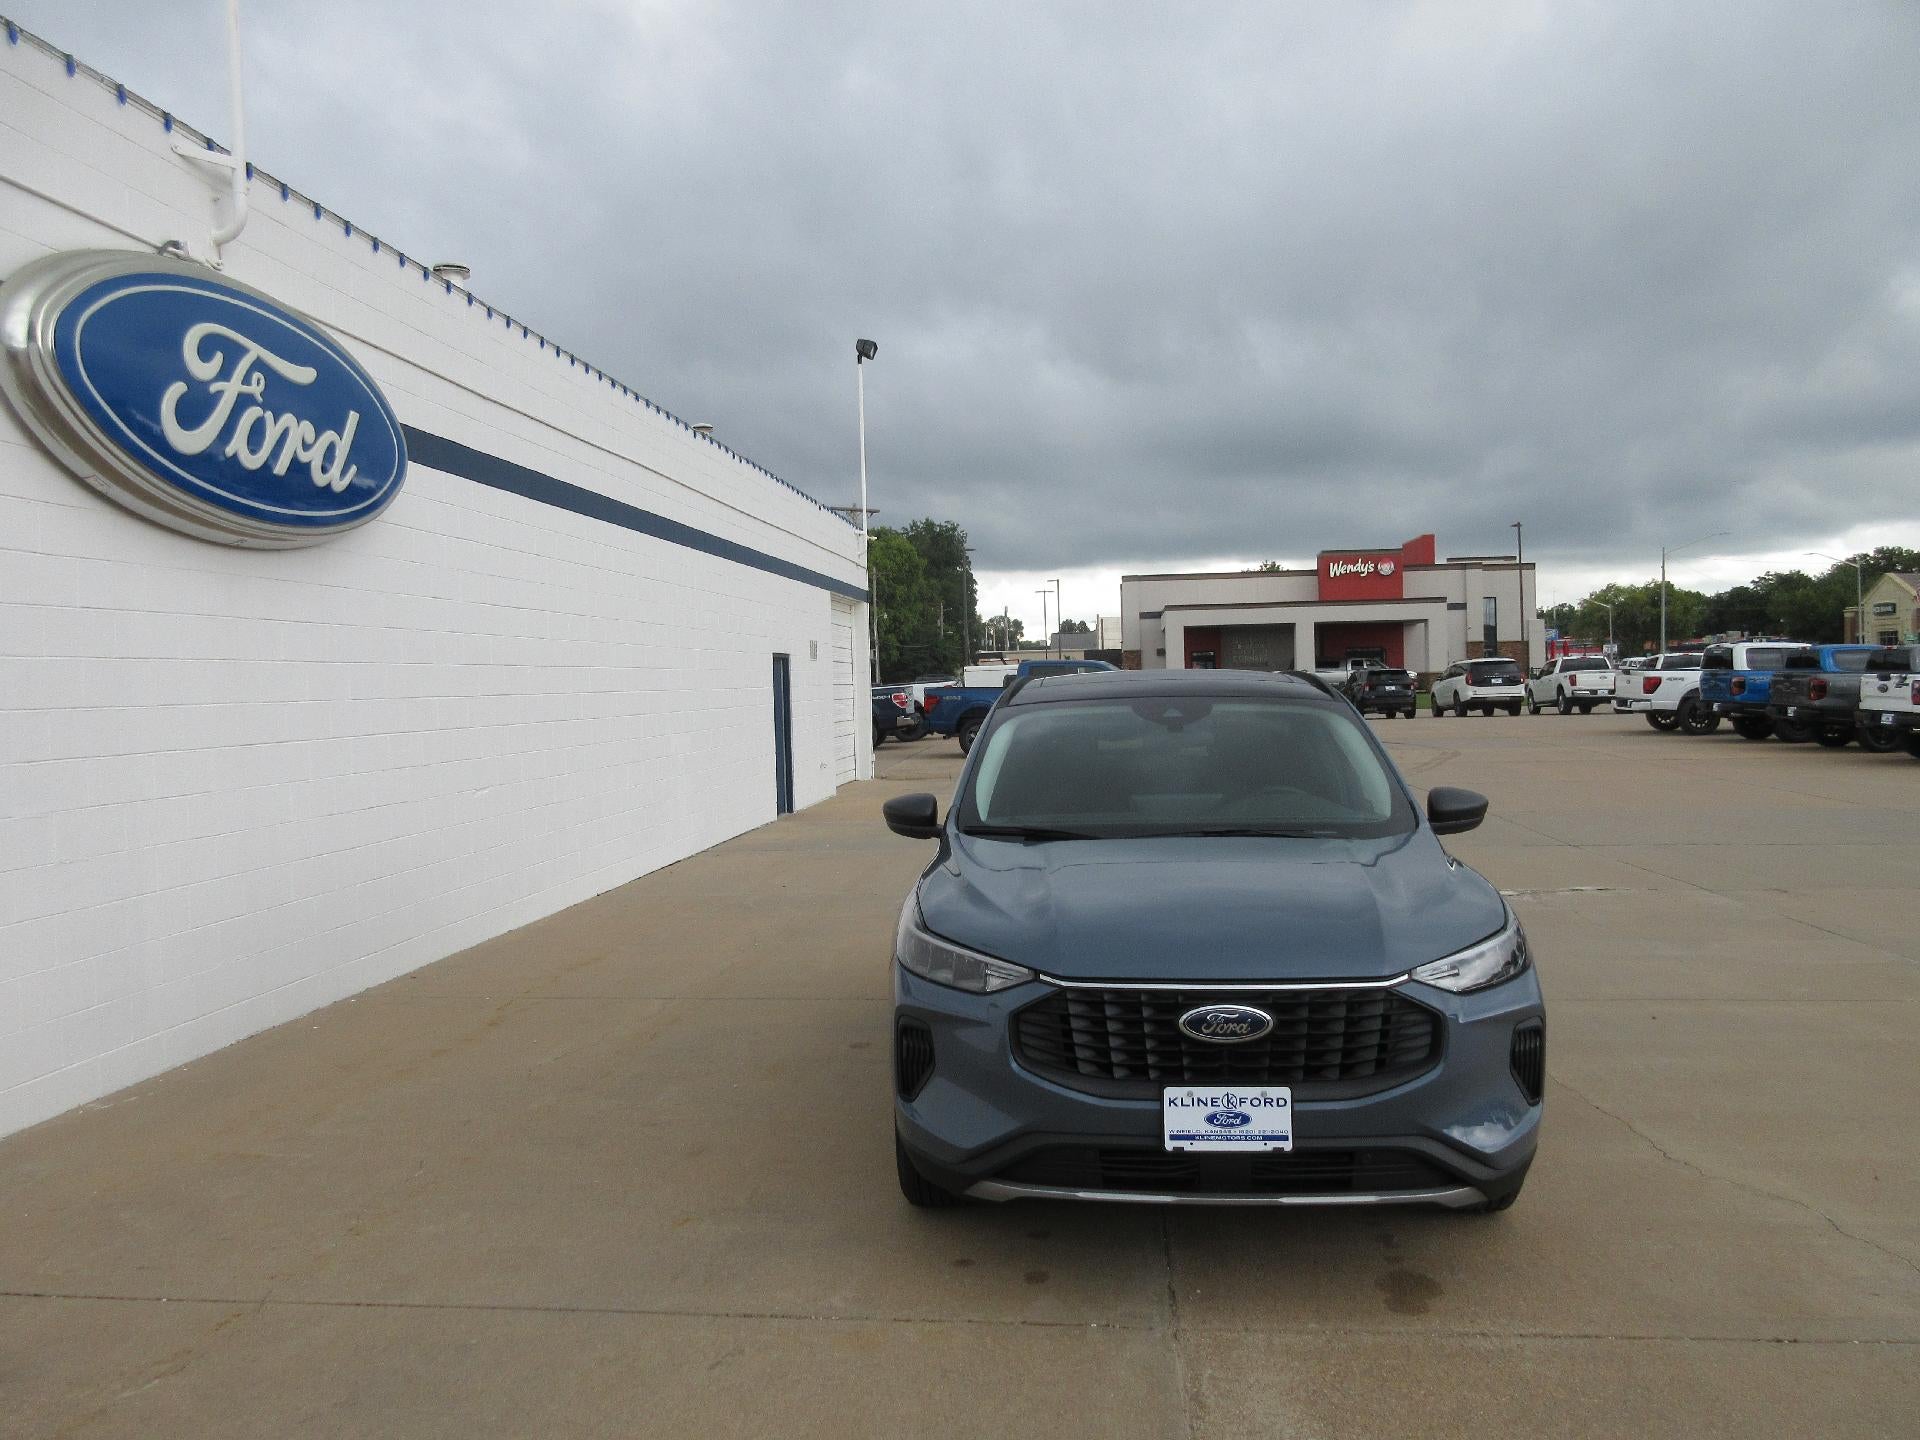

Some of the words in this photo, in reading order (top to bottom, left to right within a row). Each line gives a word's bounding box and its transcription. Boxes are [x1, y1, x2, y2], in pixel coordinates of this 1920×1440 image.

[160, 322, 359, 493] Ford
[1329, 558, 1374, 578] Wendy's
[1201, 1013, 1251, 1034] Ford
[1168, 1096, 1220, 1108] KLINE
[1239, 1097, 1288, 1108] FORD
[1213, 1112, 1242, 1125] Ford
